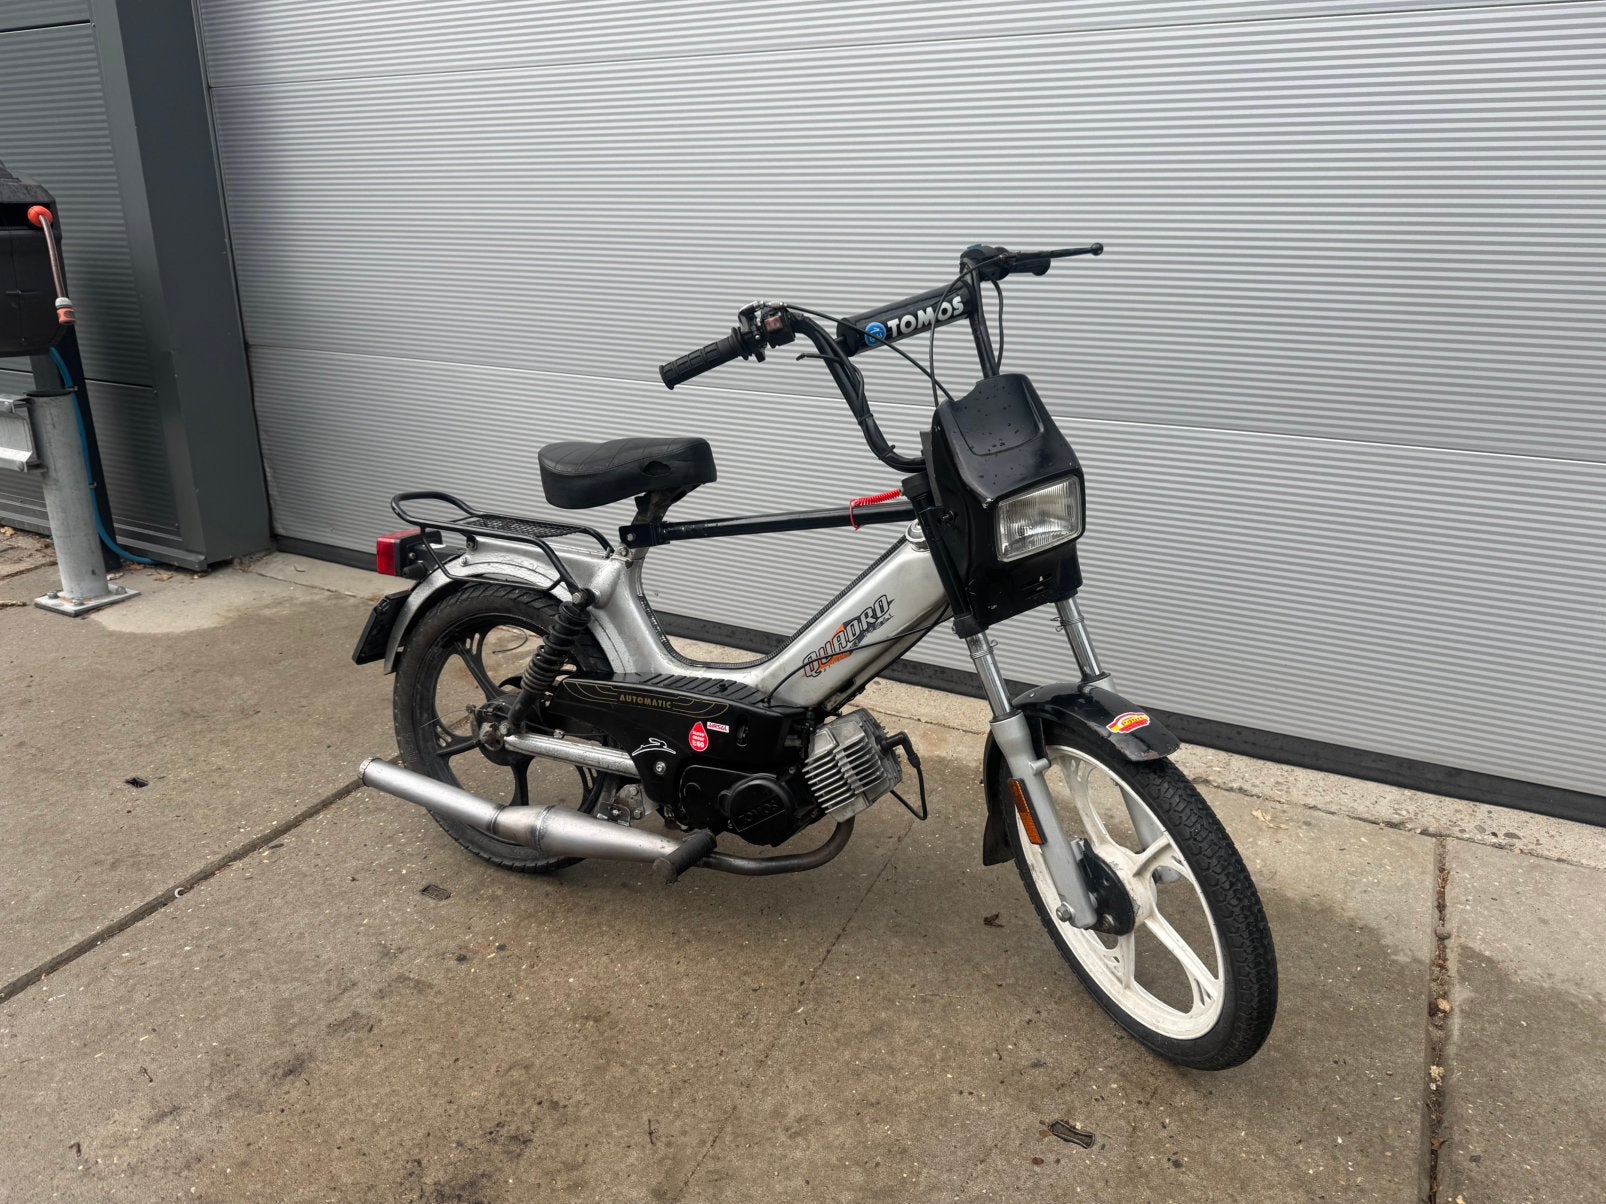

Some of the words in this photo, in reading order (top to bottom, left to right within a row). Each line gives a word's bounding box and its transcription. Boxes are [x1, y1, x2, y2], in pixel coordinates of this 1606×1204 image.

[887, 296, 964, 337] TOMOS
[802, 594, 890, 677] QUADRO
[619, 694, 672, 708] AUTOMATIC
